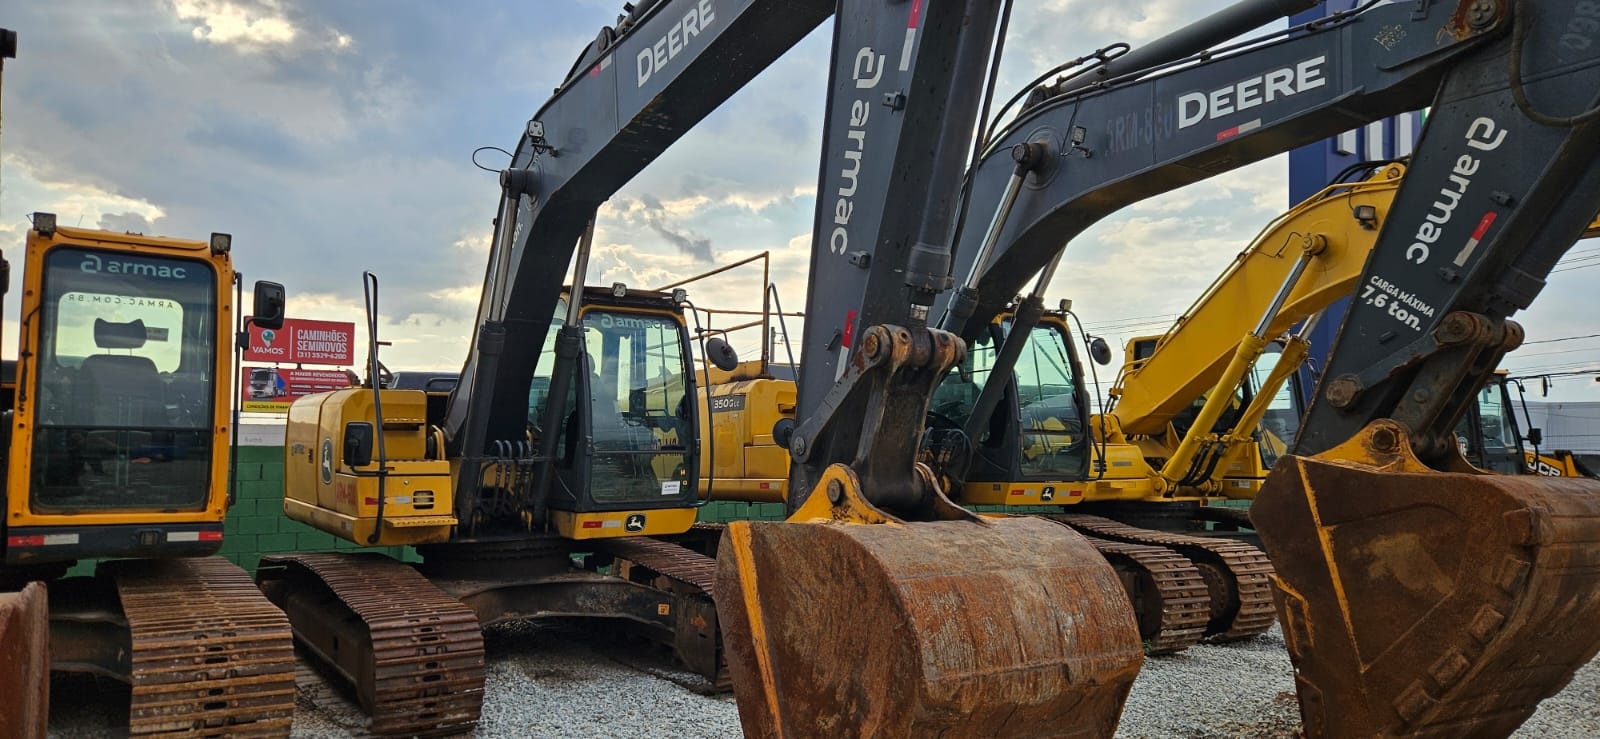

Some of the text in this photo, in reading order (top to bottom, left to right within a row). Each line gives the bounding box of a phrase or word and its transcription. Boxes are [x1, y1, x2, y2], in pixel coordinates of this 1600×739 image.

[637, 0, 715, 88] DEERE
[1178, 55, 1326, 130] DEERE
[830, 99, 870, 256] armac
[1405, 153, 1481, 265] armac
[107, 260, 187, 279] armac
[1360, 284, 1422, 331] 7,6 ton.
[1370, 275, 1435, 318] CARGA MÁXIMA
[252, 346, 284, 355] VAMOS
[297, 329, 348, 342] CAMINHÕES
[297, 340, 347, 353] SEMINOVOS
